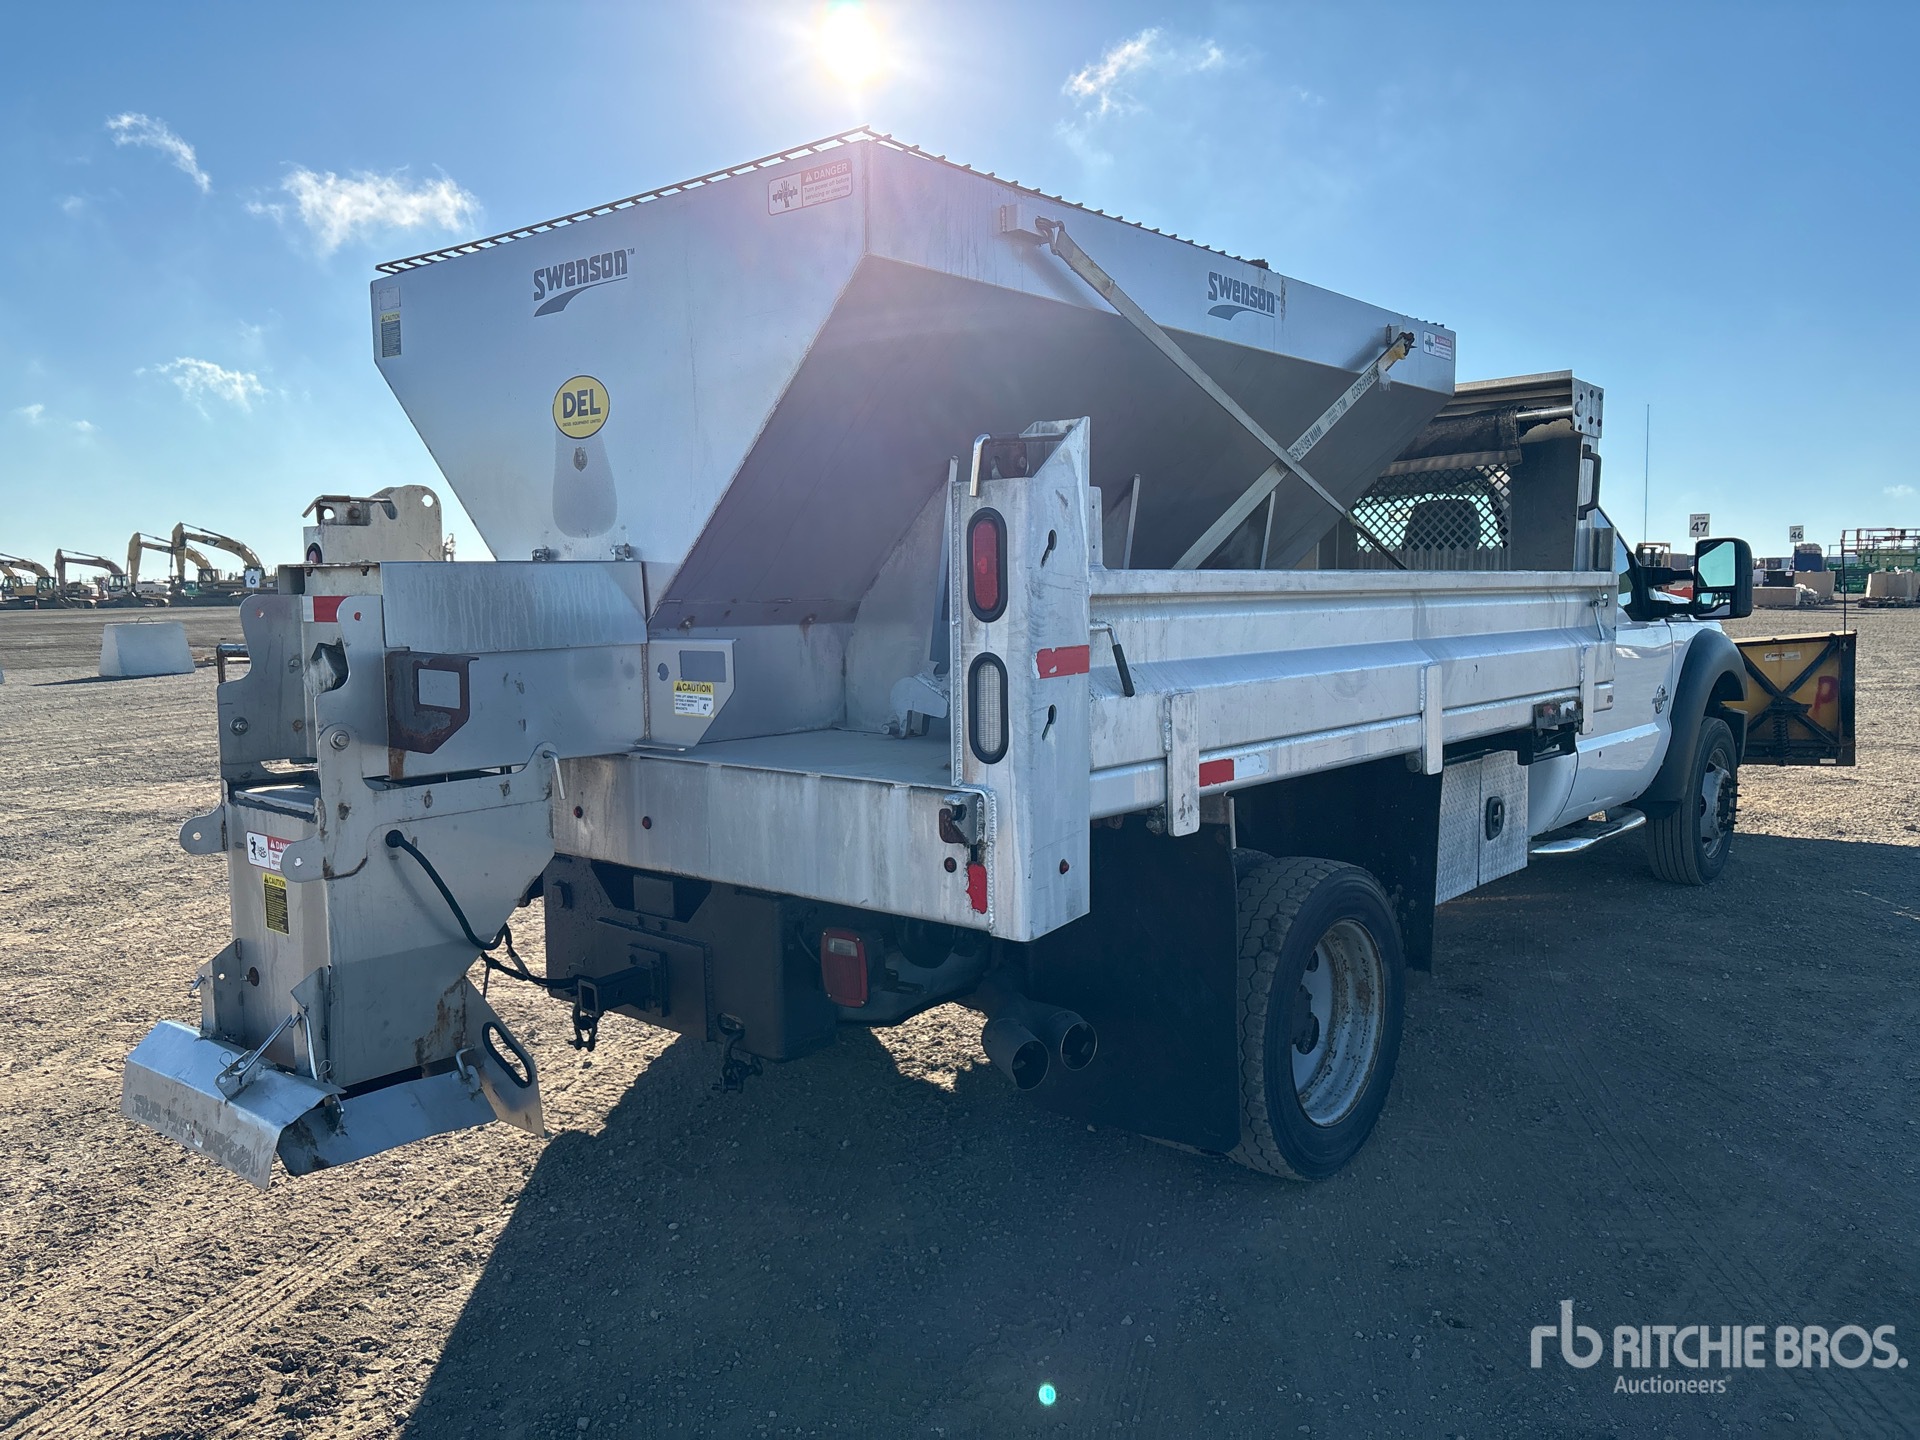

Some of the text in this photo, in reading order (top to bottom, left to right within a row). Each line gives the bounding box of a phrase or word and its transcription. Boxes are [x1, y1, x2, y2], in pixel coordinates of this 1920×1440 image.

[814, 162, 848, 180] DANGER
[562, 388, 601, 419] DEL
[1691, 521, 1709, 533] 47
[1791, 530, 1803, 540] 46
[250, 575, 256, 585] 6
[682, 683, 712, 693] CAUTION
